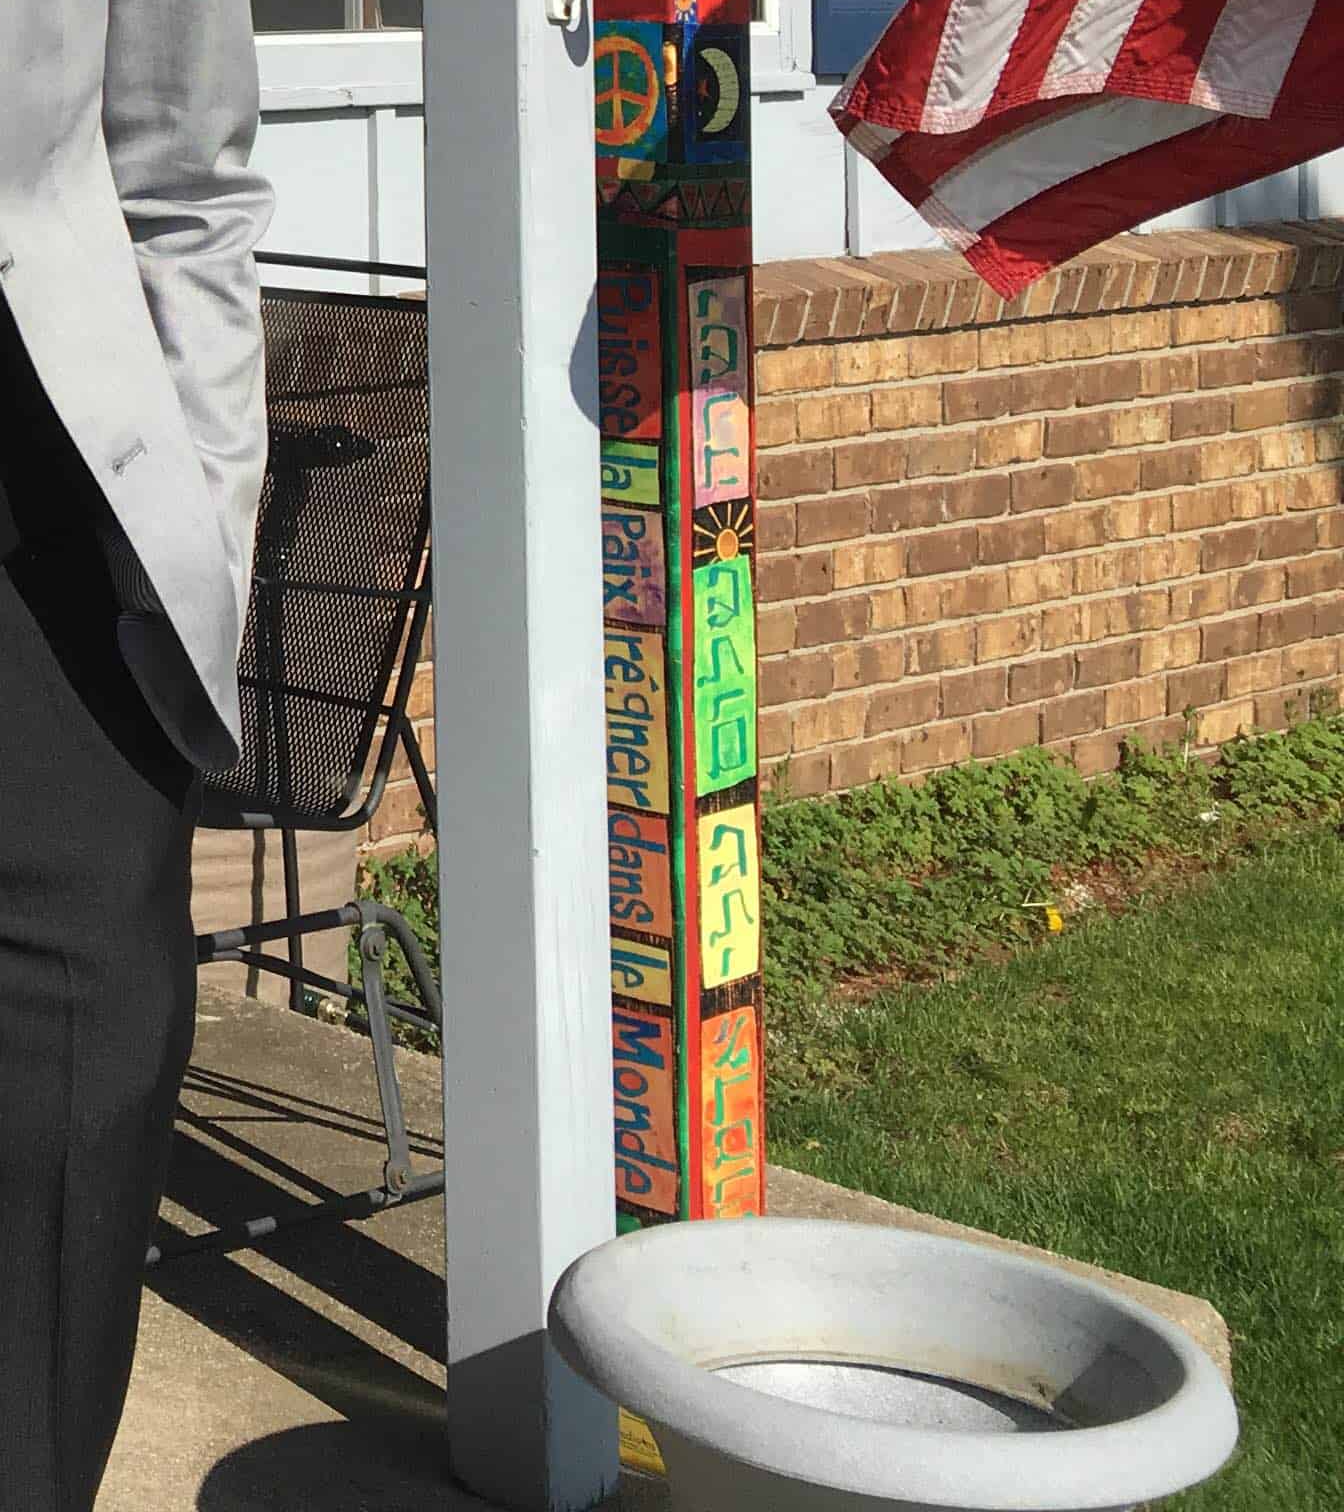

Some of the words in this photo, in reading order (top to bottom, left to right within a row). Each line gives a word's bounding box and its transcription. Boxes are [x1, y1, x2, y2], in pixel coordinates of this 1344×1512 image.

[598, 278, 652, 435] Puisse
[601, 452, 658, 491] la
[602, 512, 652, 603] Paix
[604, 632, 658, 808] régner
[697, 565, 746, 778] שלום
[607, 813, 666, 924] dans
[610, 943, 668, 990] le
[612, 1013, 676, 1194] Monde
